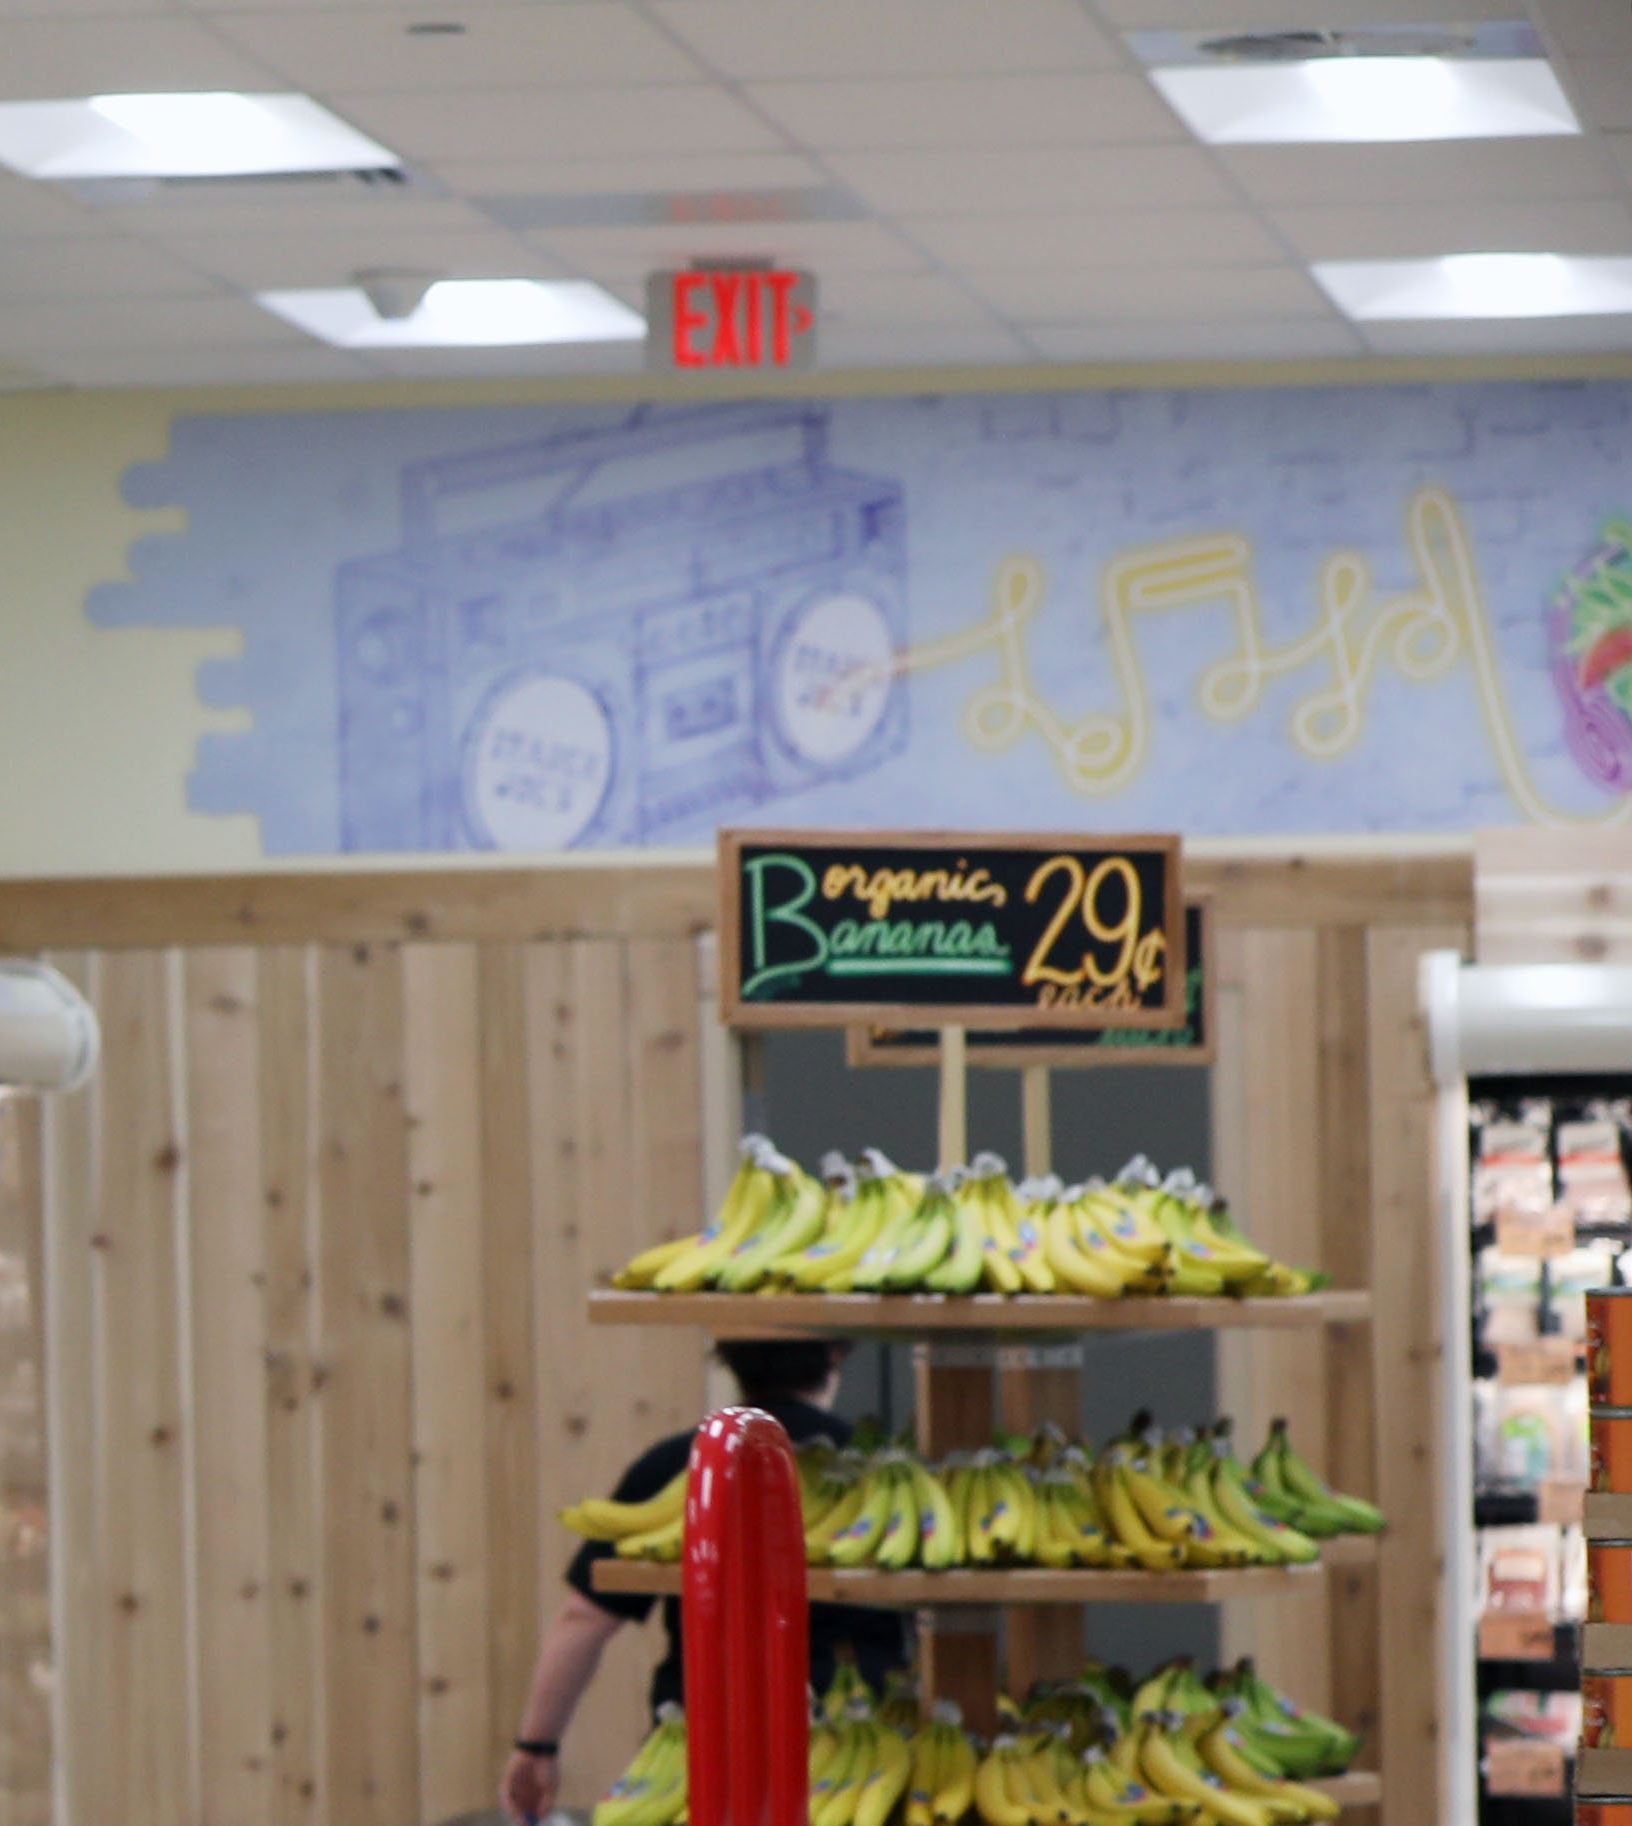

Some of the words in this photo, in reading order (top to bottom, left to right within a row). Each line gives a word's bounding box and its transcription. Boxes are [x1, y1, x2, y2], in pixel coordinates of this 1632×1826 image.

[673, 270, 800, 369] EXIT
[742, 853, 1011, 998] Bananas
[822, 858, 1007, 918] organic
